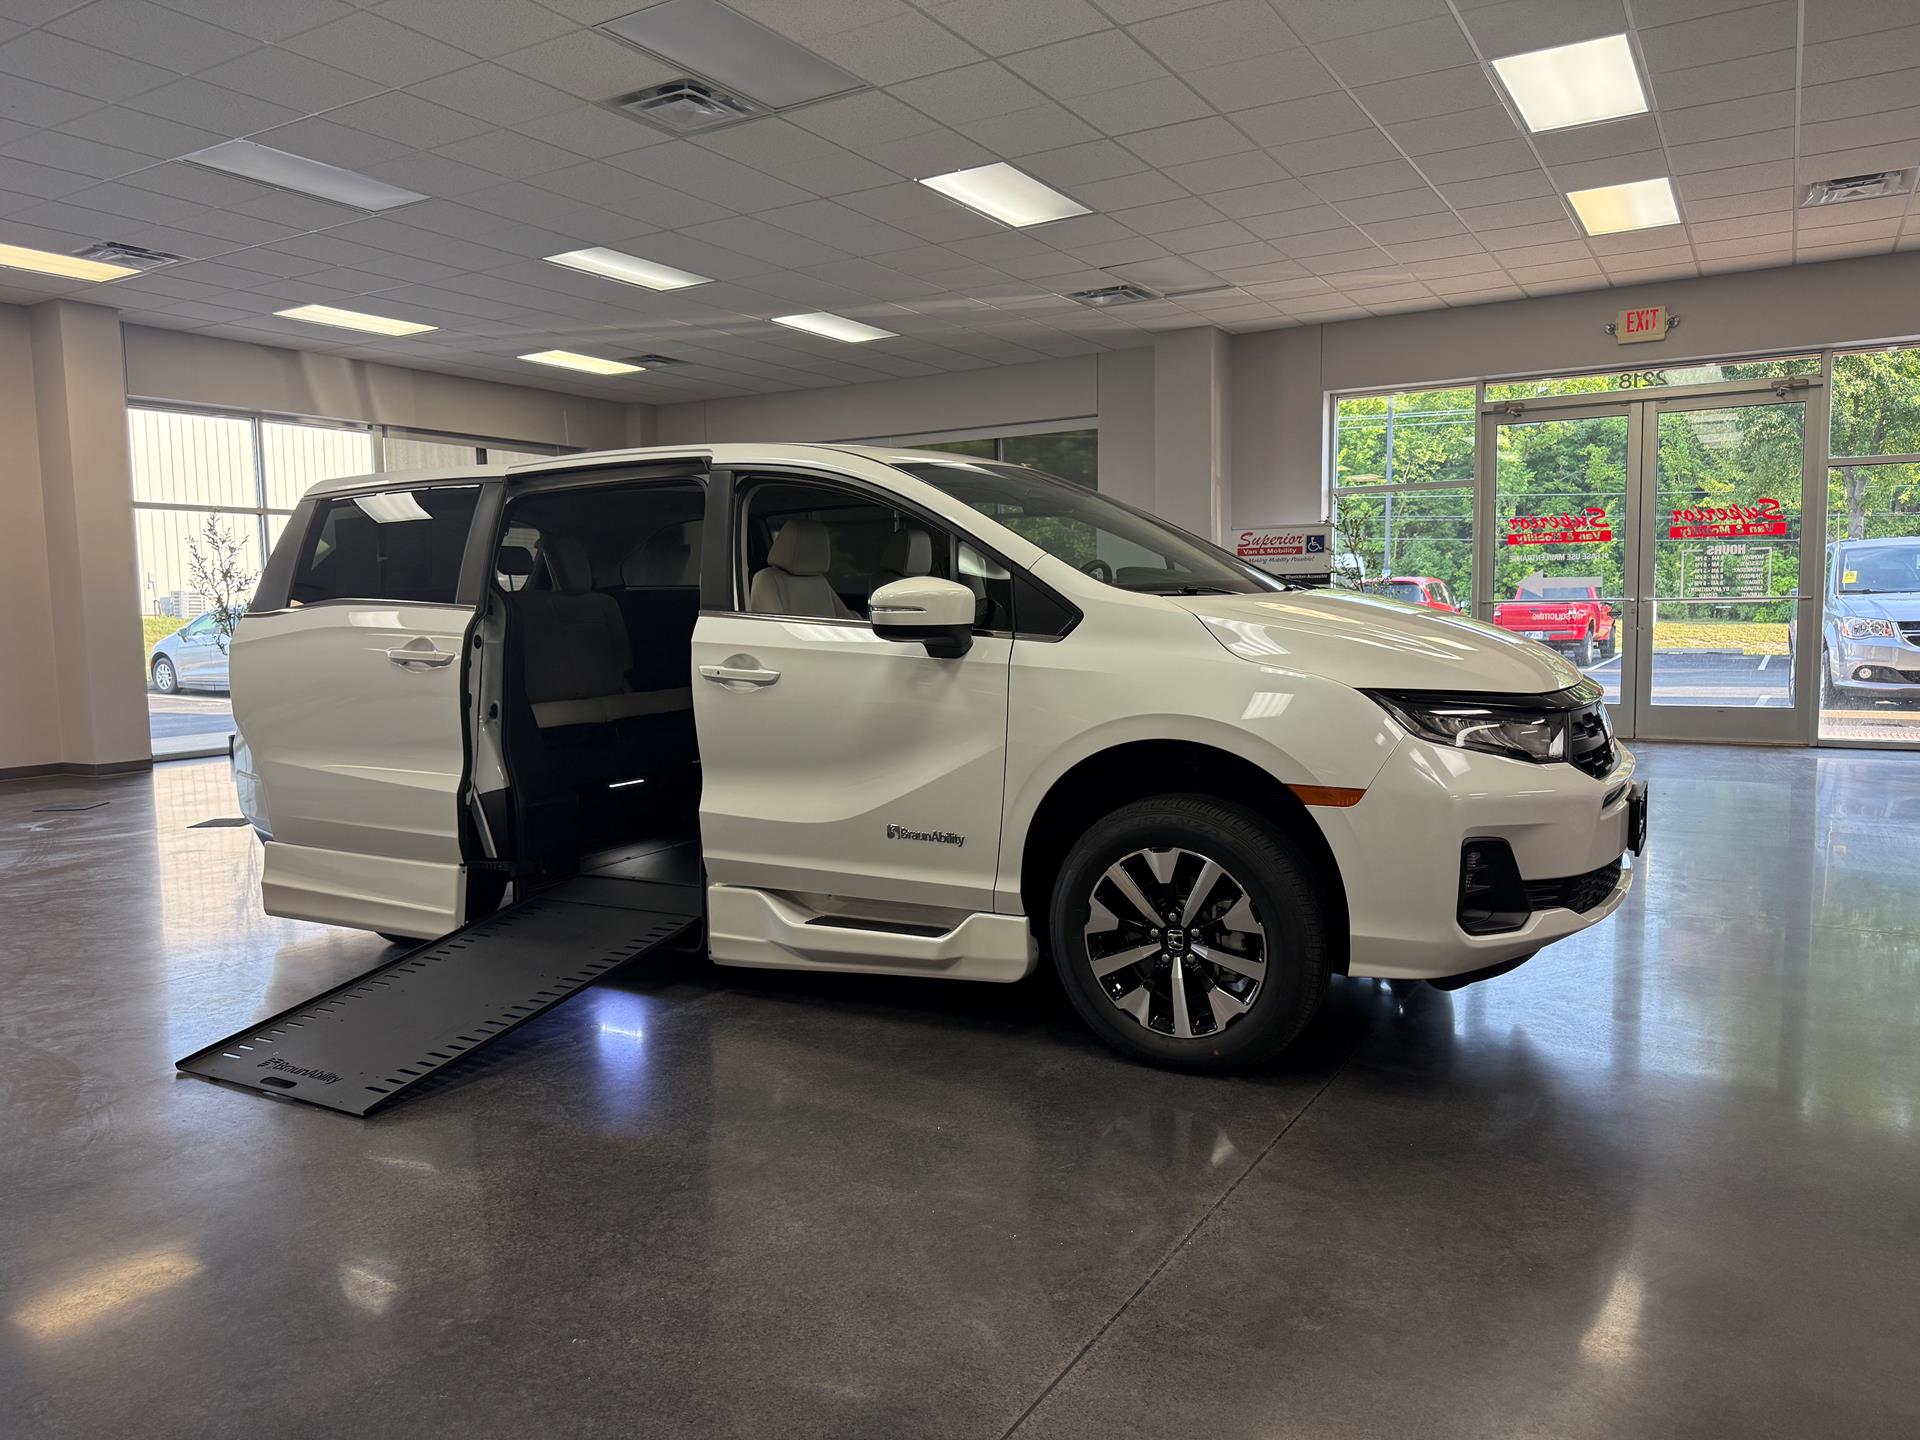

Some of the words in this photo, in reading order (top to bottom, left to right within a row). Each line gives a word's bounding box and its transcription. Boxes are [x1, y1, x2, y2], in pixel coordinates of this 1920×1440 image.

[1627, 309, 1659, 333] EXIT
[1237, 532, 1304, 548] Superior
[1266, 547, 1297, 555] Mobility
[901, 827, 965, 847] BraunAbility
[271, 1061, 344, 1085] BraunAbility
